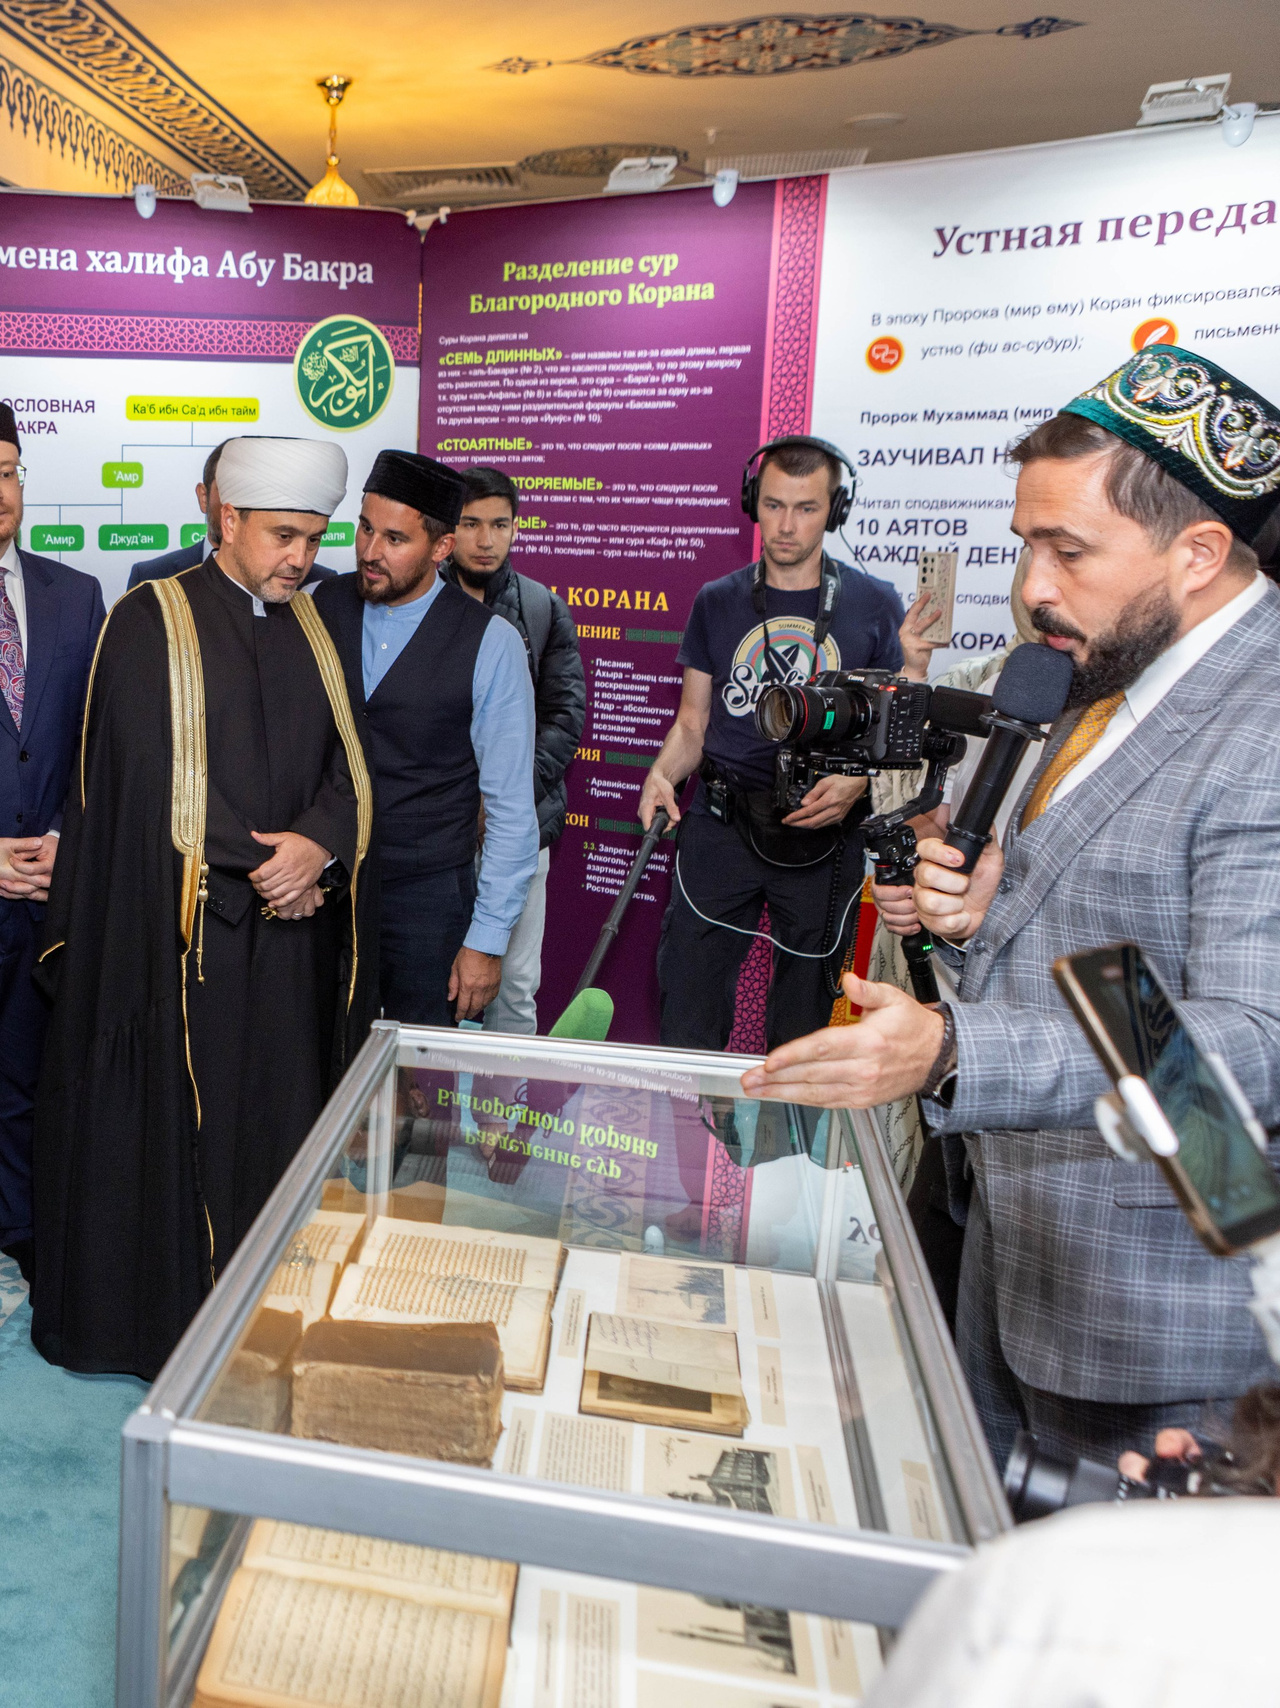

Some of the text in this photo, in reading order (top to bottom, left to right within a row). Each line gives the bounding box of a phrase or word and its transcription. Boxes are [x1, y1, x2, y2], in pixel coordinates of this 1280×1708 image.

[933, 221, 1084, 258] Устная
[86, 245, 209, 282] халифа
[216, 249, 276, 285] Абу
[283, 253, 373, 289] Бакра
[504, 253, 678, 282] Разделение сур
[470, 282, 714, 314] Благородного Корана
[872, 284, 1280, 327] В эпоху Пророка (мир ему) Коран фиксировался
[921, 336, 1084, 360] устно (фи ас-судур);
[439, 348, 562, 365] «СЕМЬ ДЛИННЫХ»
[159, 404, 178, 416] ибн
[209, 405, 227, 415] ибн
[232, 406, 257, 416] тайм
[860, 406, 1053, 426] Пророк Мухаммад (мир
[437, 437, 532, 451] «СТОАЯТНЫЕ»
[858, 448, 984, 466] ЗАУЧИВАЛ
[857, 498, 900, 509] Читал
[857, 519, 968, 536] 10 АЯТОВ
[966, 546, 1019, 566] ДЕН
[568, 587, 669, 612] КОРАНА
[596, 658, 634, 670] Писания;
[595, 669, 623, 680] Ахыра
[632, 674, 656, 683] конец
[848, 674, 865, 682] Canon
[594, 681, 650, 692] воскрешение
[602, 692, 648, 704] воздаяние;
[594, 700, 614, 712] Кадр
[623, 704, 674, 716] абсолютное
[601, 713, 662, 725] вневременное
[593, 724, 636, 733] всезнание
[600, 734, 664, 748] всемогущество
[591, 778, 640, 790] Аравийские
[590, 788, 622, 799] Притчи.
[584, 842, 596, 850] 3.3.
[599, 844, 634, 856] Запреты
[588, 853, 628, 867] Алкоголь,
[587, 864, 624, 876] азартные
